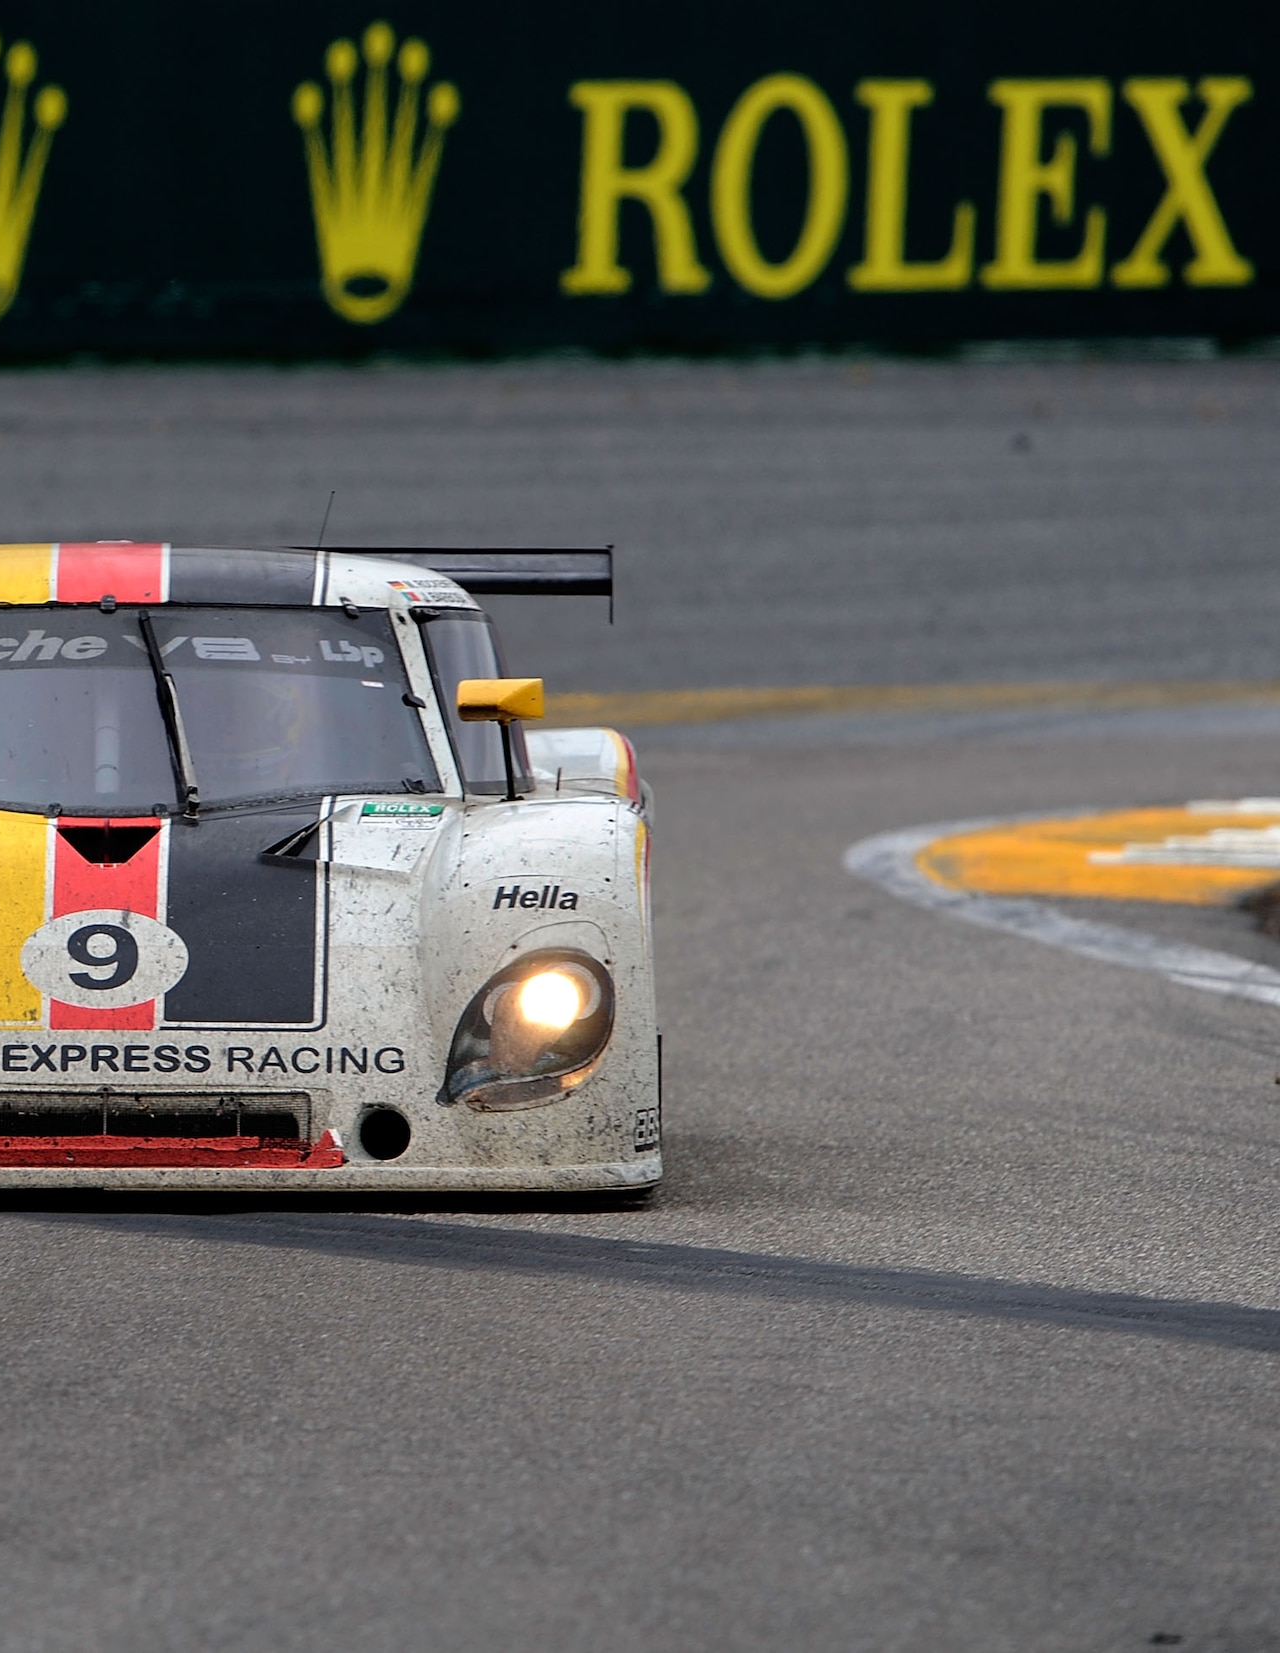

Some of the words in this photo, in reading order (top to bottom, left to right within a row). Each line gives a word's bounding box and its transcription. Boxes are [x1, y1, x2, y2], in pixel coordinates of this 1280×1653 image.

[560, 73, 1254, 299] ROLEX
[373, 803, 432, 814] ROLEX
[493, 885, 579, 911] Hella
[66, 923, 139, 991] 9
[1, 1043, 212, 1074] EXPRESS
[223, 1046, 406, 1075] RACING
